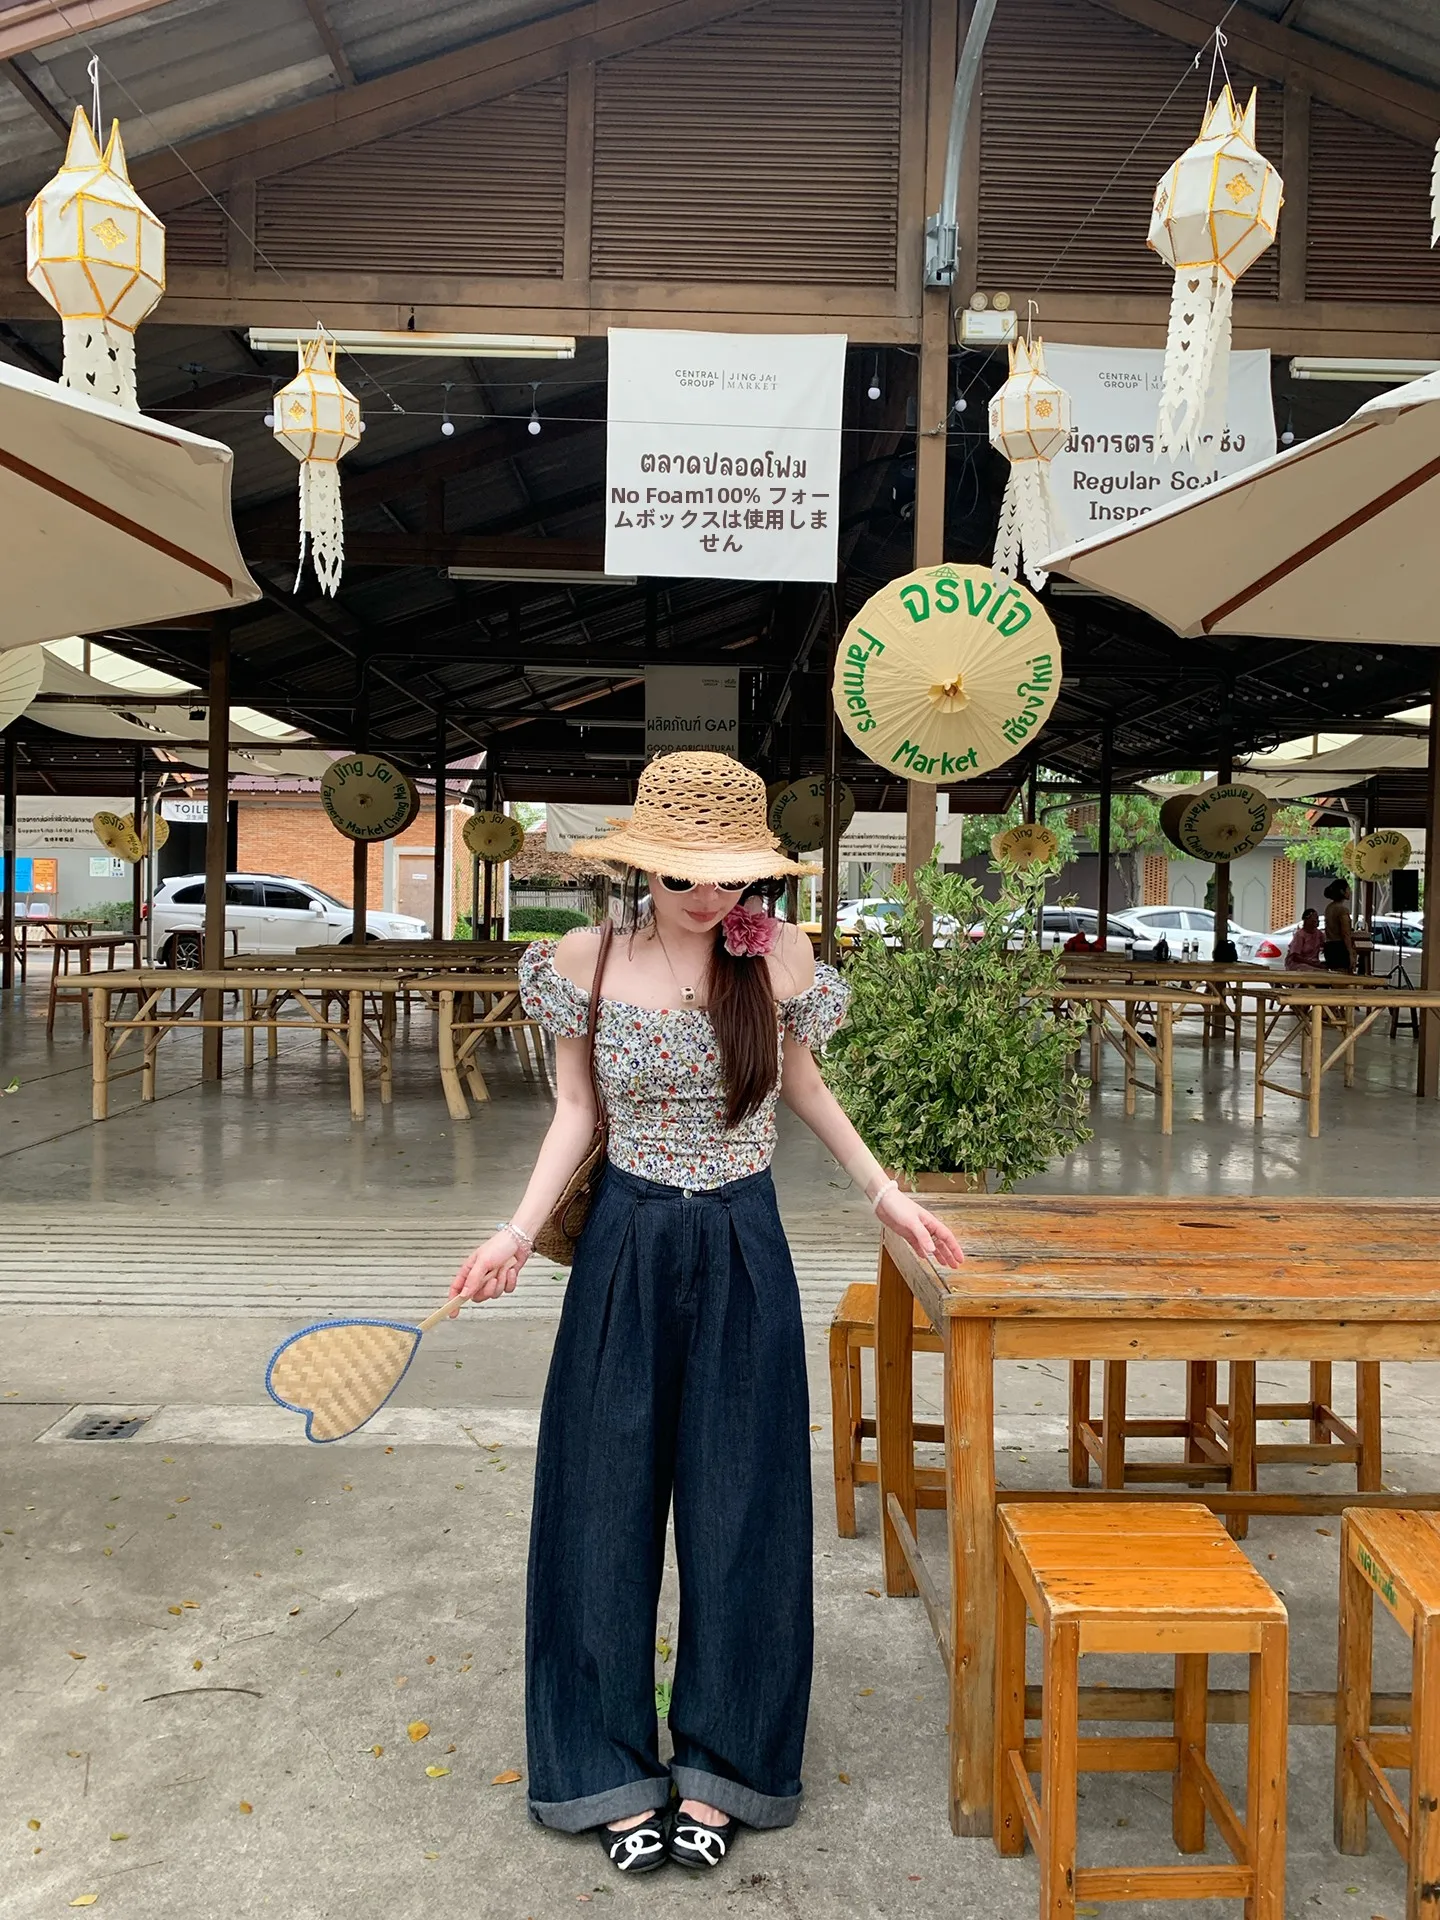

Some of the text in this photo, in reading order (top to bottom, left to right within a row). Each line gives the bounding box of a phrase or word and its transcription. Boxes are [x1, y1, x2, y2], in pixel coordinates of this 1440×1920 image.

[675, 369, 719, 379] CENTRAL
[730, 373, 776, 382] JING JAI
[1098, 372, 1143, 382] CENTRAL
[680, 379, 715, 388] GROUP
[727, 381, 778, 391] MARKET
[1103, 381, 1139, 389] GROUP
[640, 450, 807, 479] ตลาดปลอดโฟม
[1073, 470, 1228, 494] Regular Scal
[611, 487, 640, 504] No
[647, 487, 761, 504] Foam100%
[699, 534, 743, 553] せん
[843, 627, 978, 776] Farmers Market
[705, 719, 737, 732] GAP
[646, 744, 674, 752] GOOD
[333, 761, 393, 786] Jing Jai
[1209, 788, 1254, 805] Farmers
[175, 804, 208, 814] TOILE
[323, 783, 409, 836] Farmers Market Chiang Mai
[1183, 799, 1211, 832] Market
[772, 789, 812, 851] Farmers Market
[1233, 802, 1268, 854] Jing Jai
